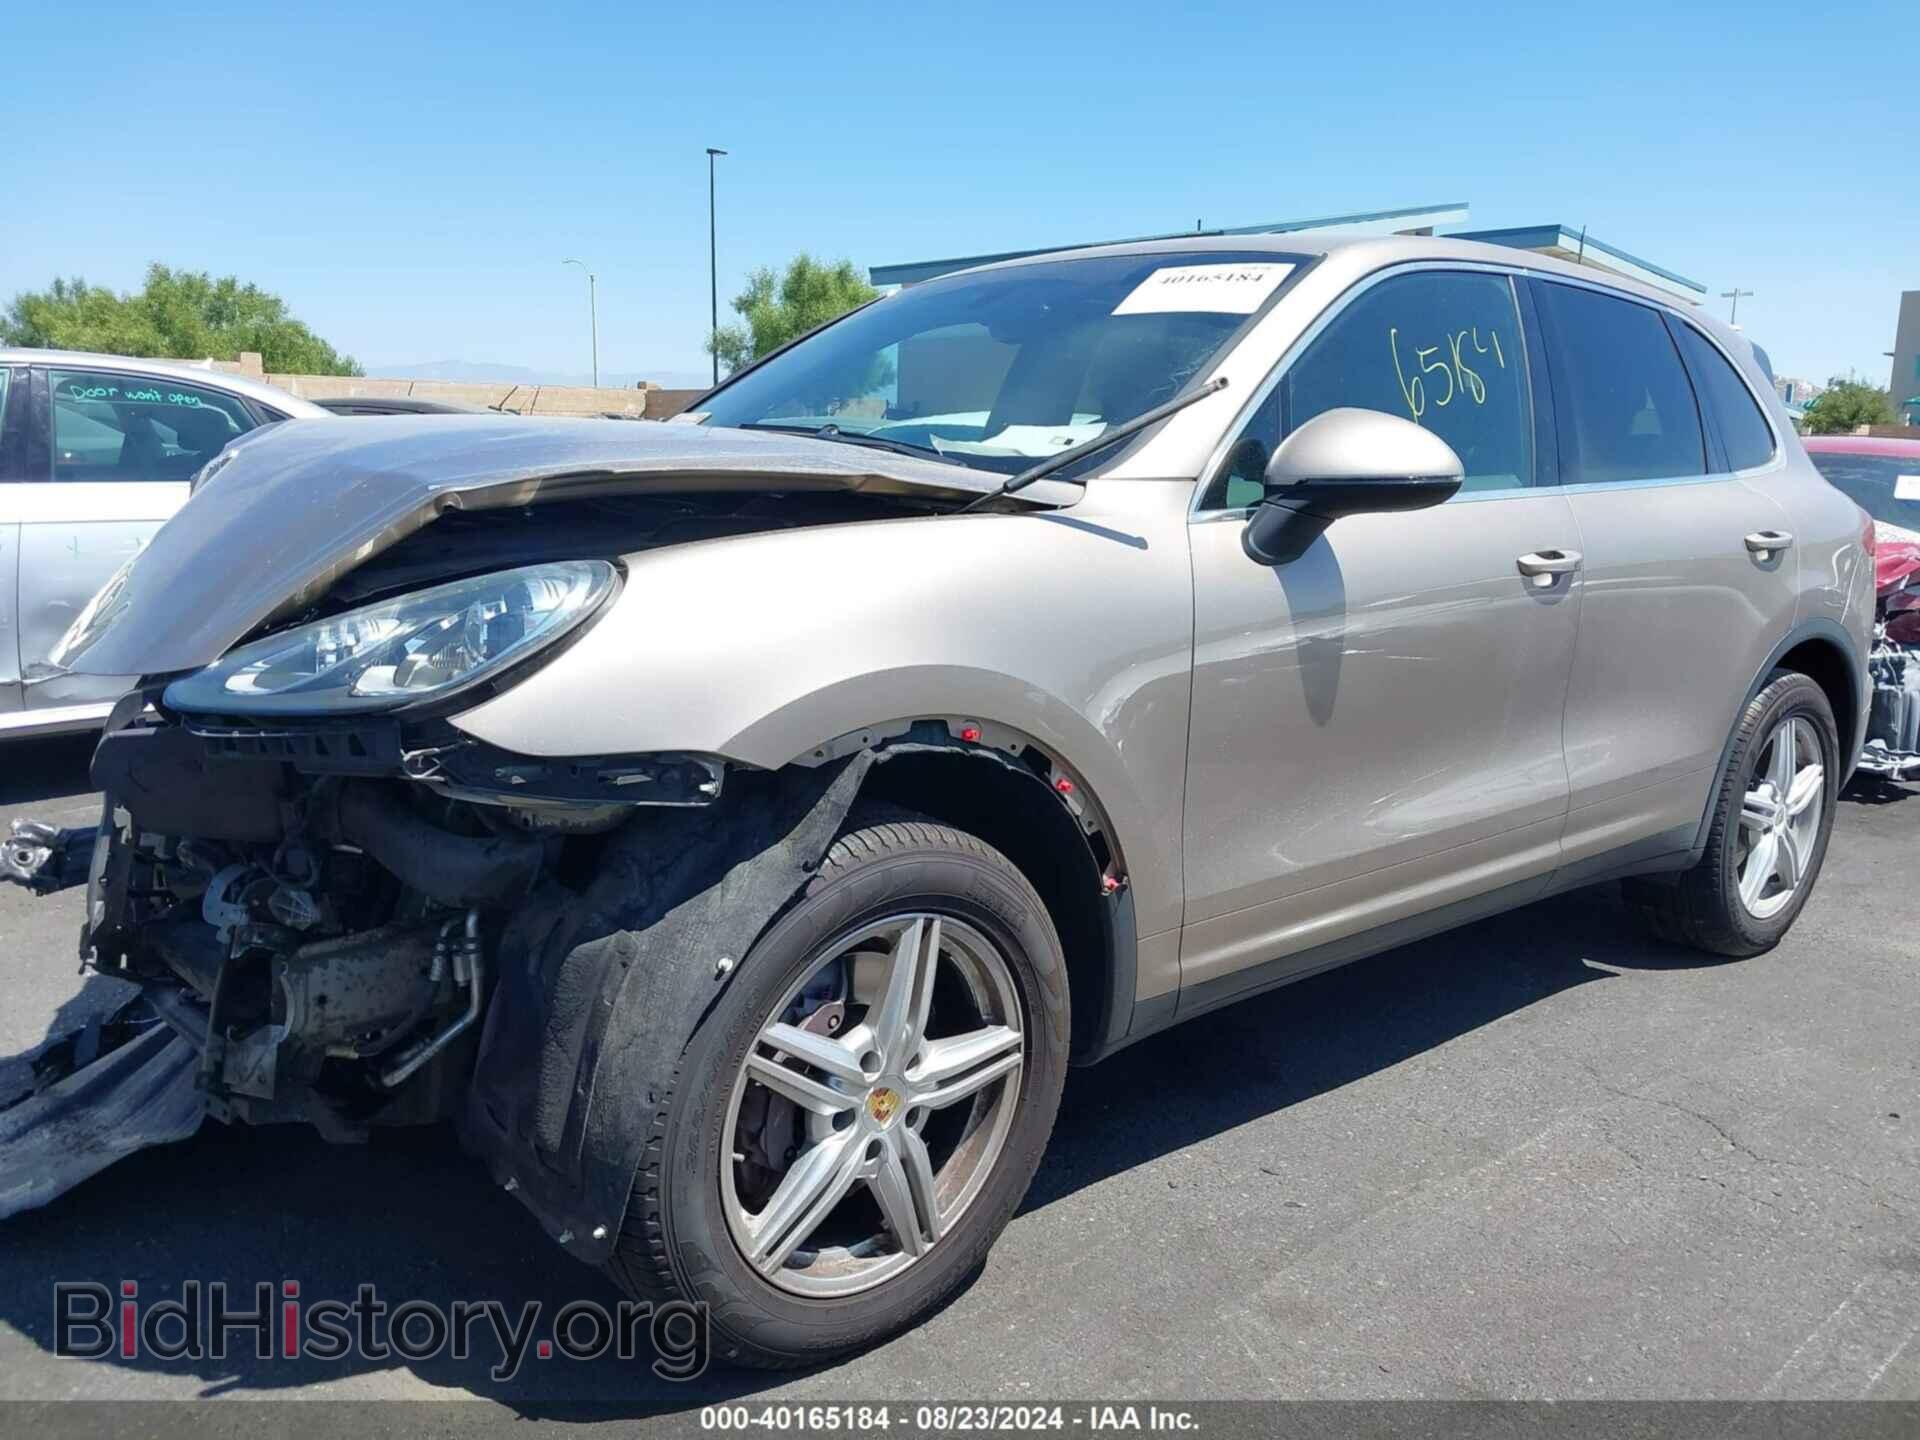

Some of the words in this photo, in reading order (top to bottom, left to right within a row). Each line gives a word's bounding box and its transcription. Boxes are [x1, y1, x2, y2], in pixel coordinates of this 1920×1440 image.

[69, 384, 119, 400] Door
[168, 393, 202, 408] open
[1390, 327, 1505, 425] 65184
